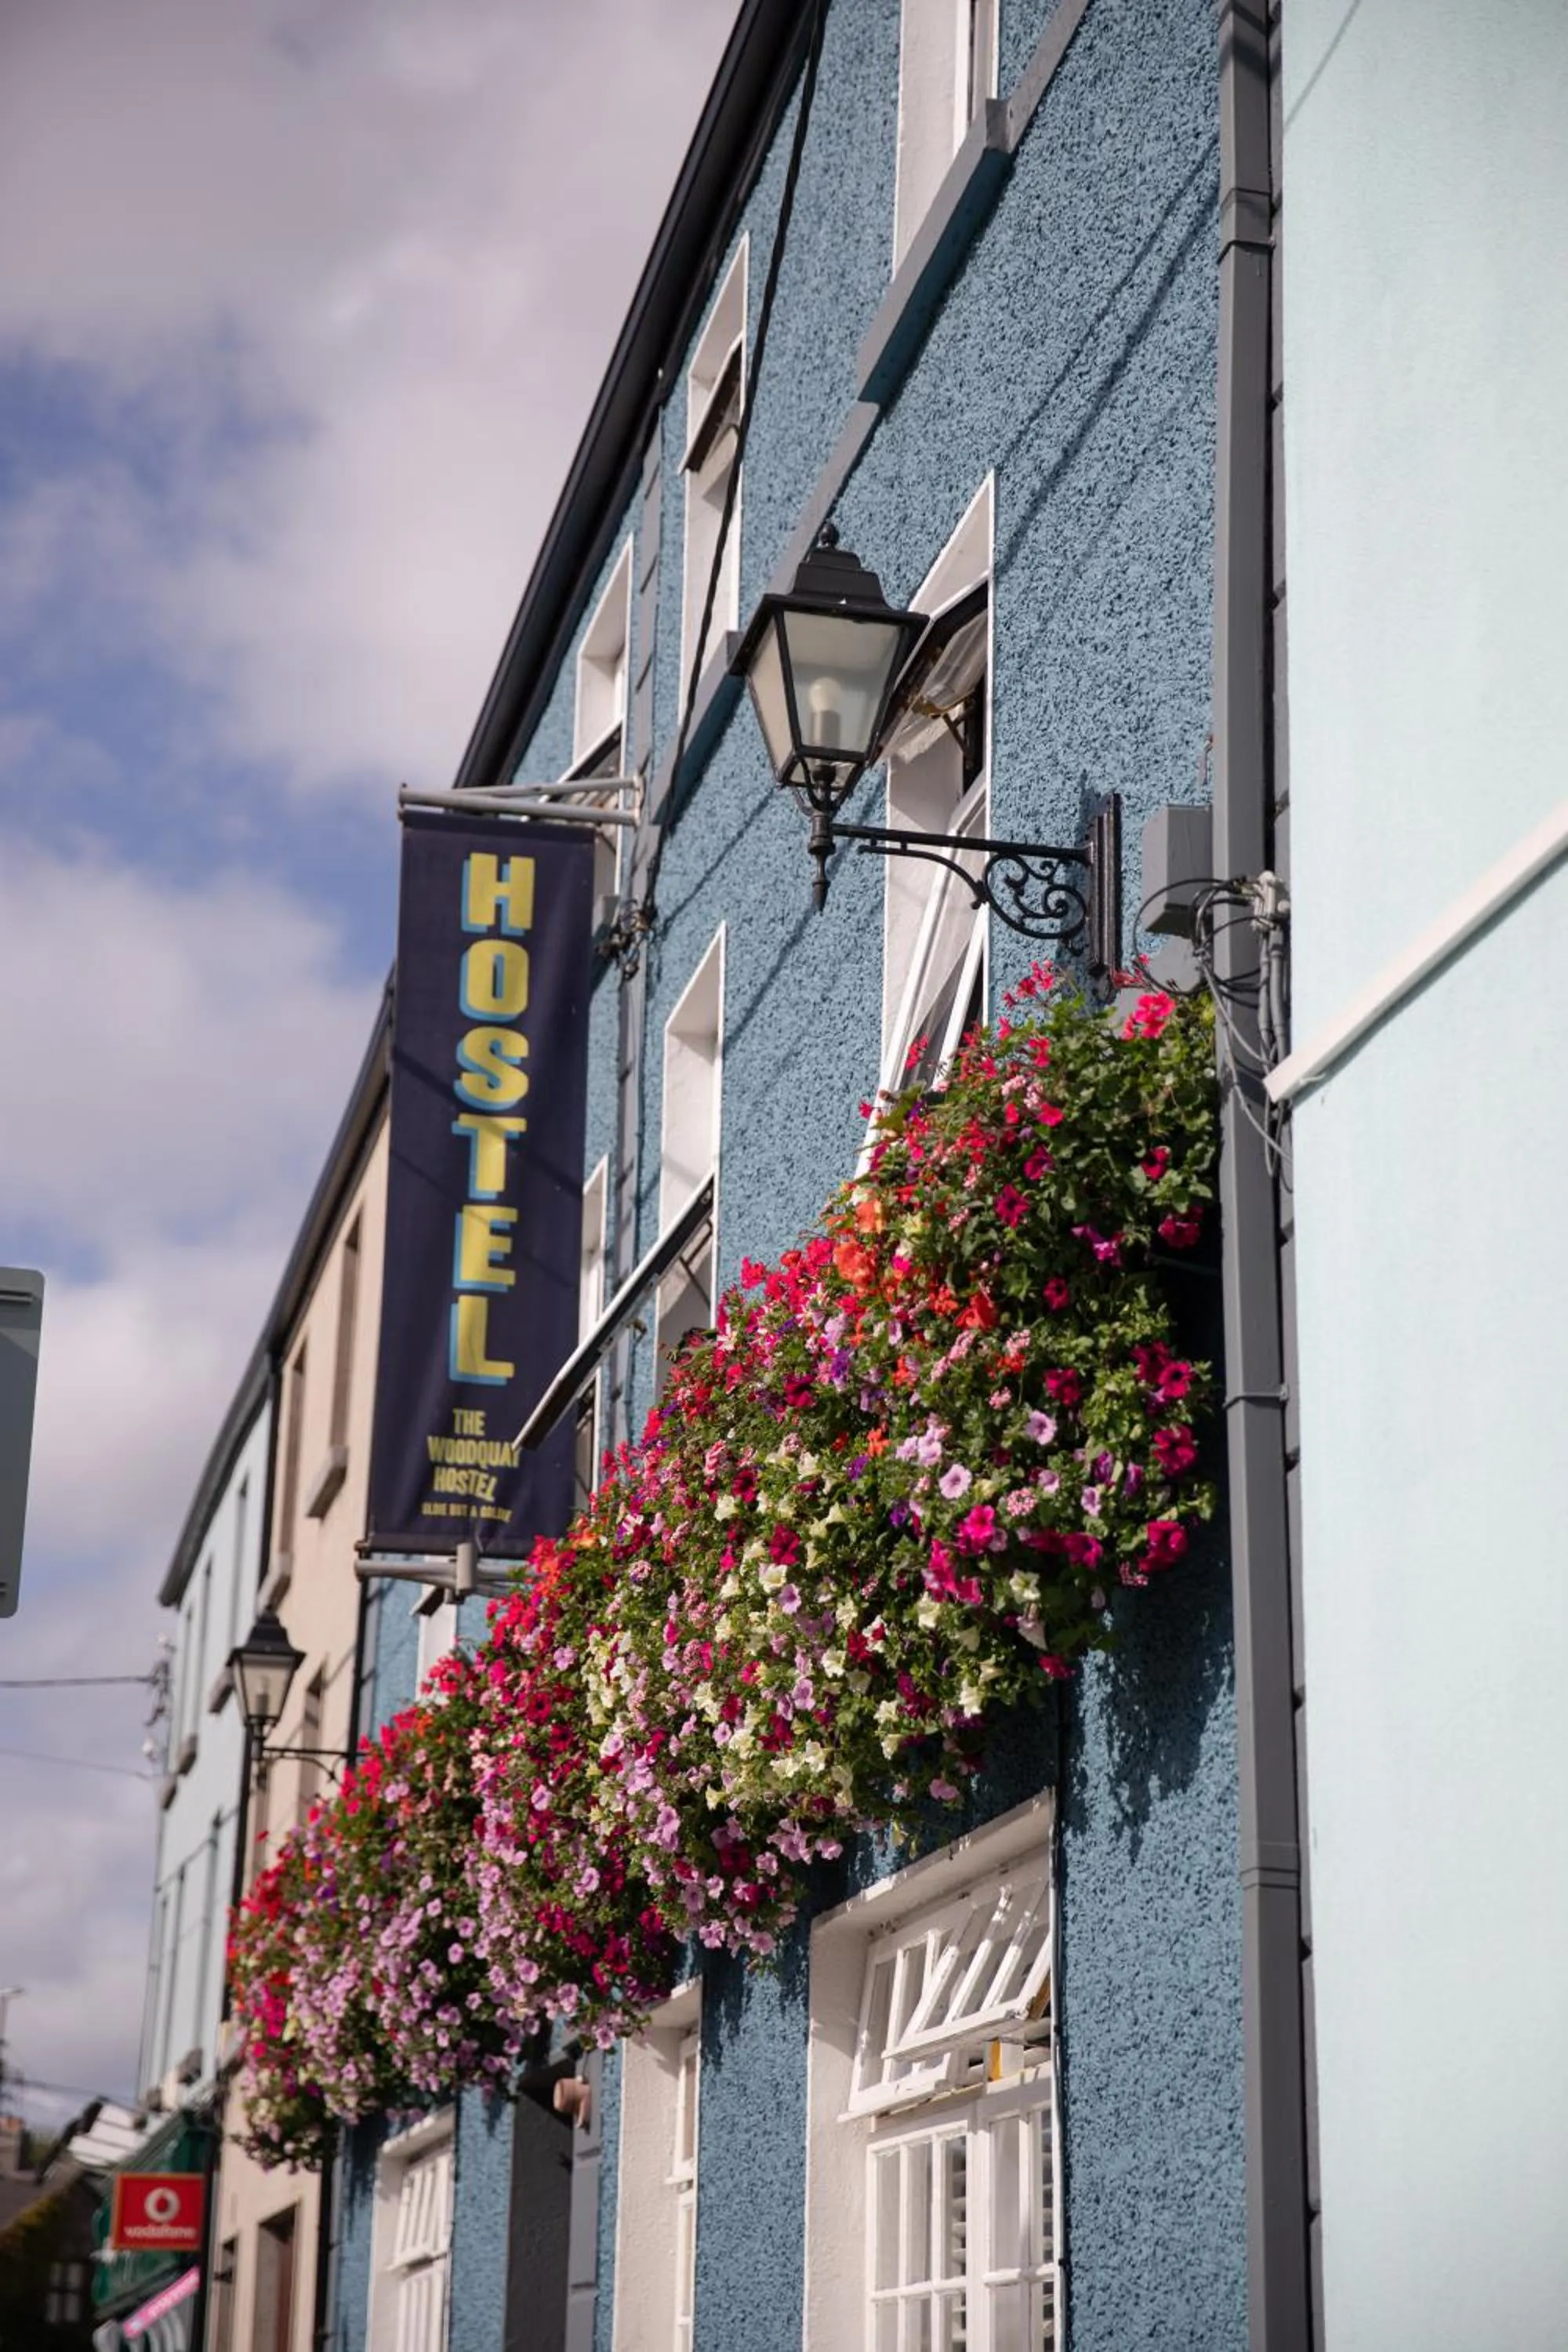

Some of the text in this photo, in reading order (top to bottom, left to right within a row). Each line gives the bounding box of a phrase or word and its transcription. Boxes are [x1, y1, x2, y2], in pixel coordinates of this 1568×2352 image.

[449, 852, 535, 1385] HOSTEL
[452, 1408, 485, 1436] THE
[426, 1436, 521, 1468] WOODQUAY
[434, 1467, 497, 1502] HOSTEL
[470, 1505, 477, 1517] A
